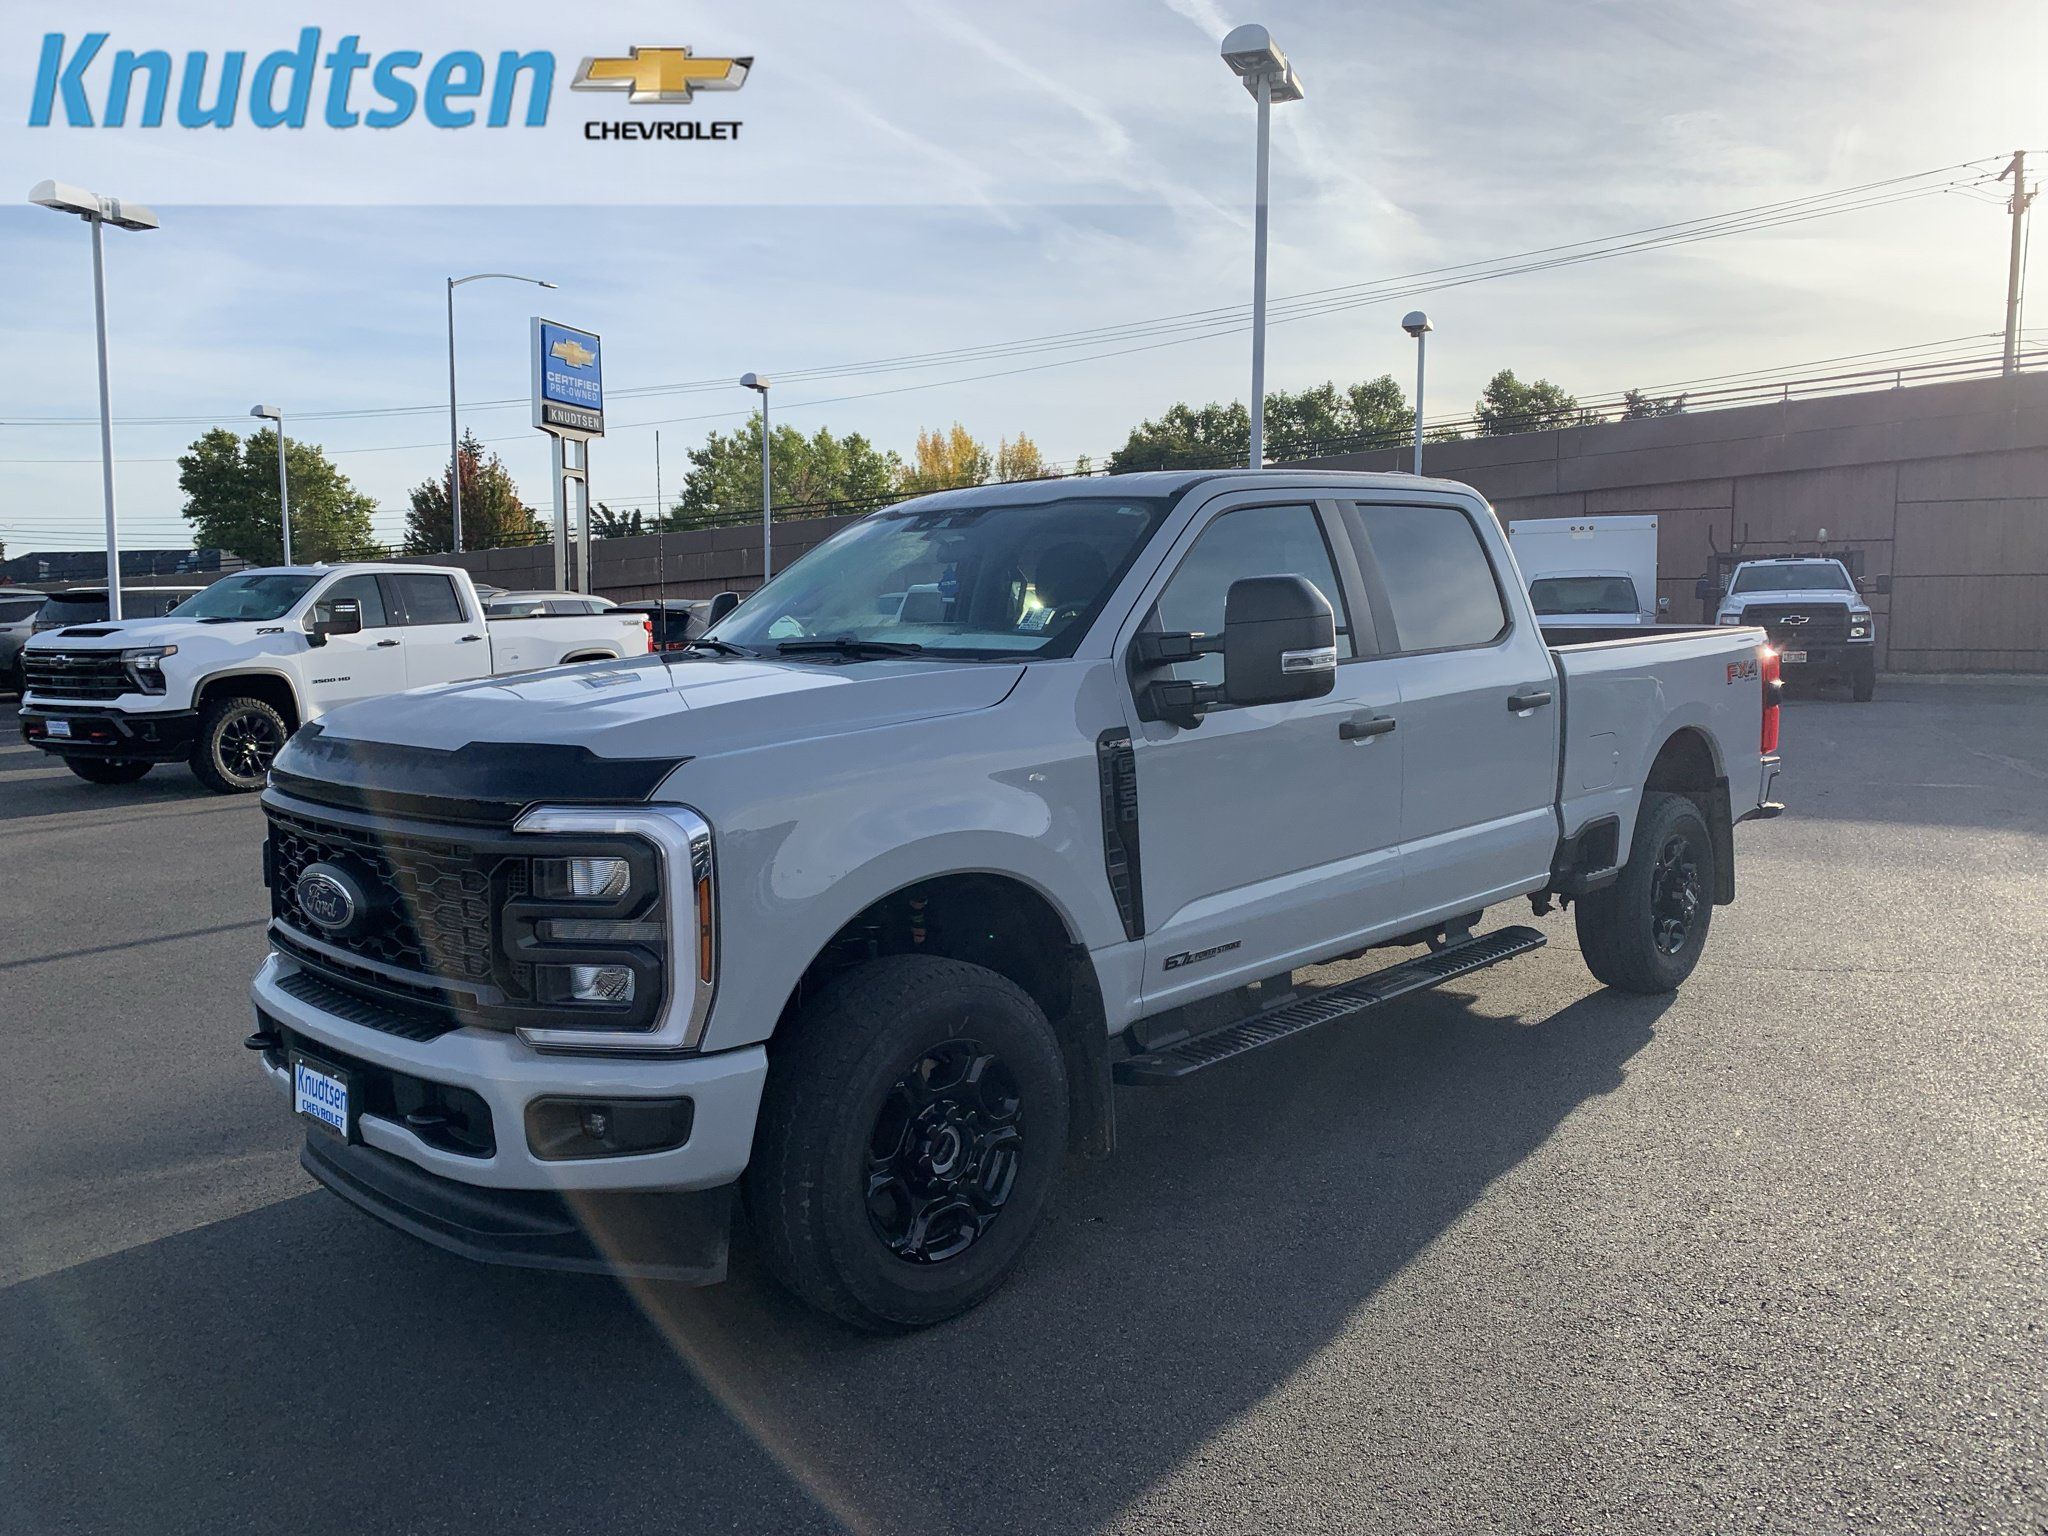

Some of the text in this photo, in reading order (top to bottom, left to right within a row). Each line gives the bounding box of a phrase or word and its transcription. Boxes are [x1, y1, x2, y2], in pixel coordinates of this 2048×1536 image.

[547, 371, 600, 392] CERTIFIED
[550, 383, 598, 401] PRE-OWNED
[551, 408, 600, 428] KNUDTSEN
[1726, 659, 1758, 685] FX4
[307, 883, 337, 918] Ford
[1217, 940, 1242, 954] STROKE
[298, 1066, 347, 1112] Knudtsen
[302, 1100, 344, 1128] CHEVROLET
